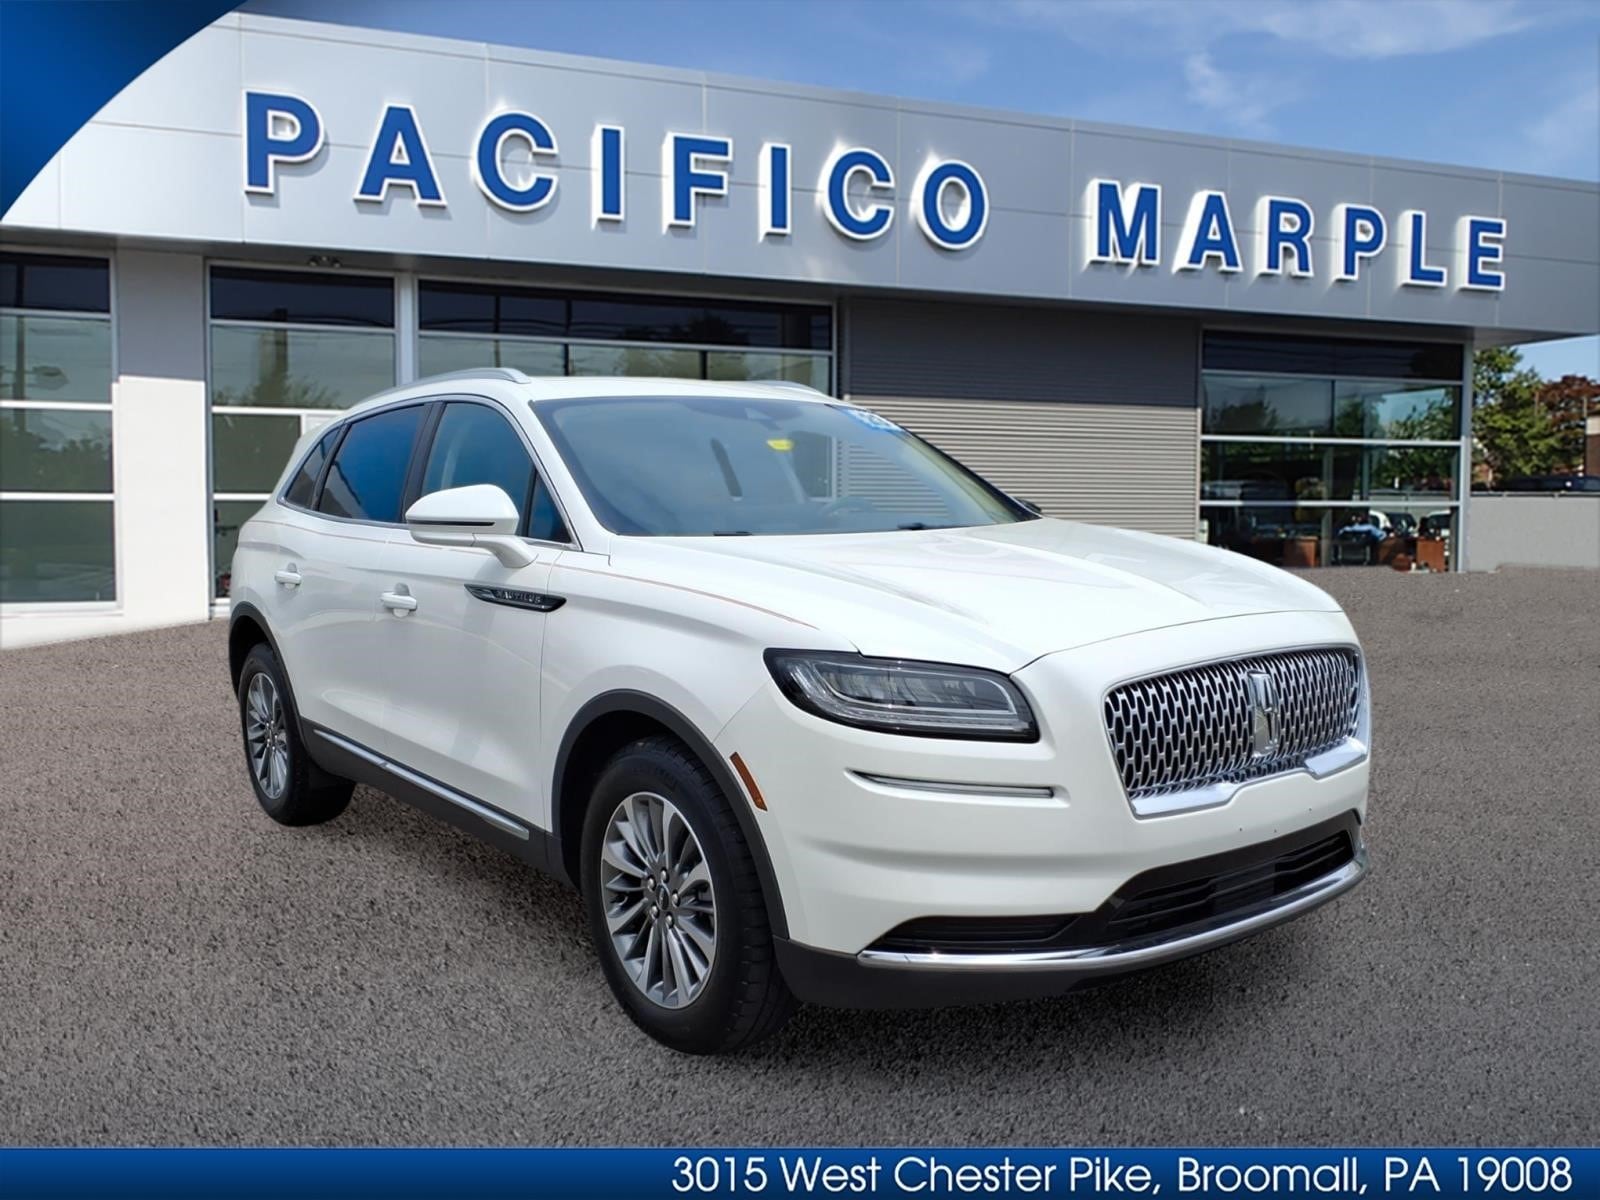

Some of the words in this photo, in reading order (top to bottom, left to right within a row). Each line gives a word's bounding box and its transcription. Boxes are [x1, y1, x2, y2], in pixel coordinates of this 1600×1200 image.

[244, 90, 988, 249] PACIFICO
[1093, 180, 1507, 290] MARPLE
[496, 590, 541, 603] NAUTILUS
